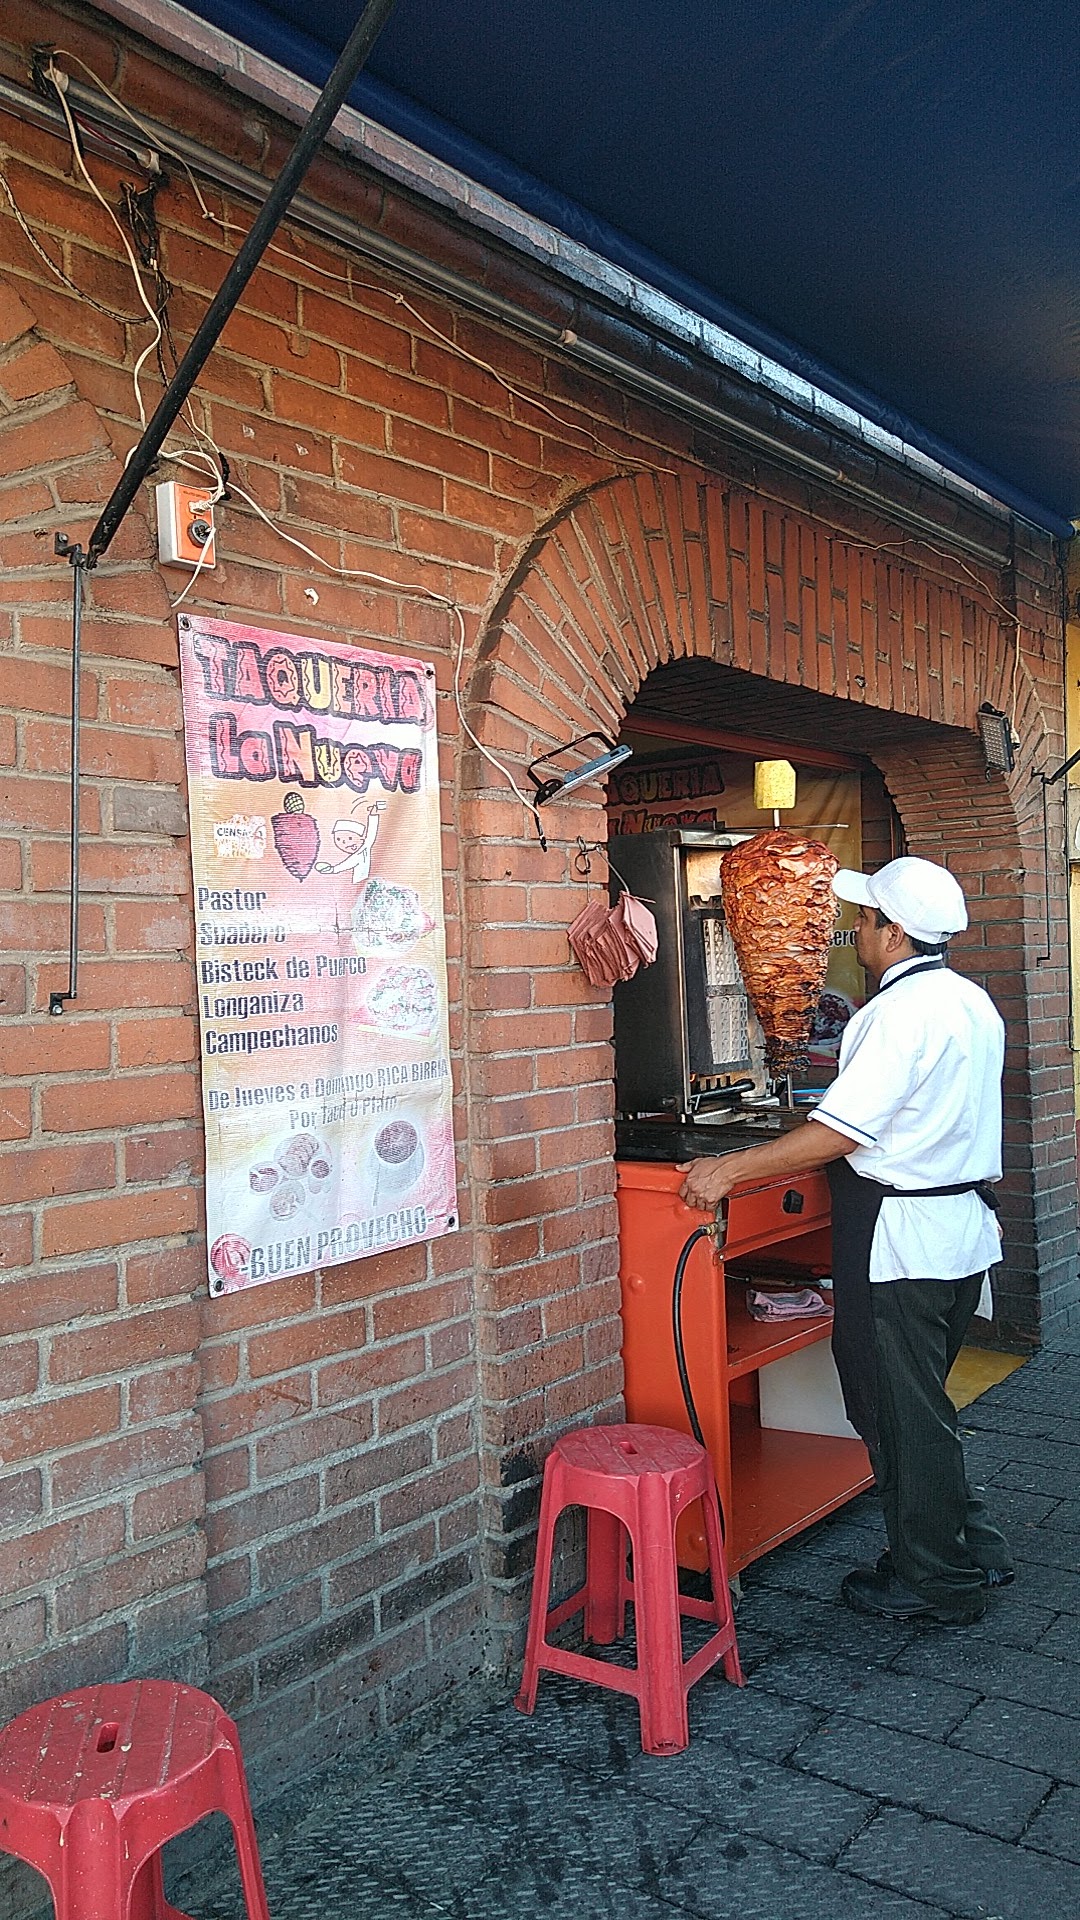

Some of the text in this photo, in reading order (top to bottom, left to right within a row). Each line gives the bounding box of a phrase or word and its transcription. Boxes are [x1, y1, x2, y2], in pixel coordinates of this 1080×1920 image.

[194, 634, 427, 725] TAQUERIA
[210, 712, 423, 793] La Nueva
[198, 886, 267, 911] Pastor
[199, 922, 286, 946] Suadero
[201, 954, 367, 984] Bisteck de Puerco
[204, 991, 304, 1019] Longaniza
[205, 1023, 338, 1055] Campechanos
[209, 1058, 449, 1110] De Jueves a Domingo RICA BIRRIA
[289, 1109, 318, 1130] Por
